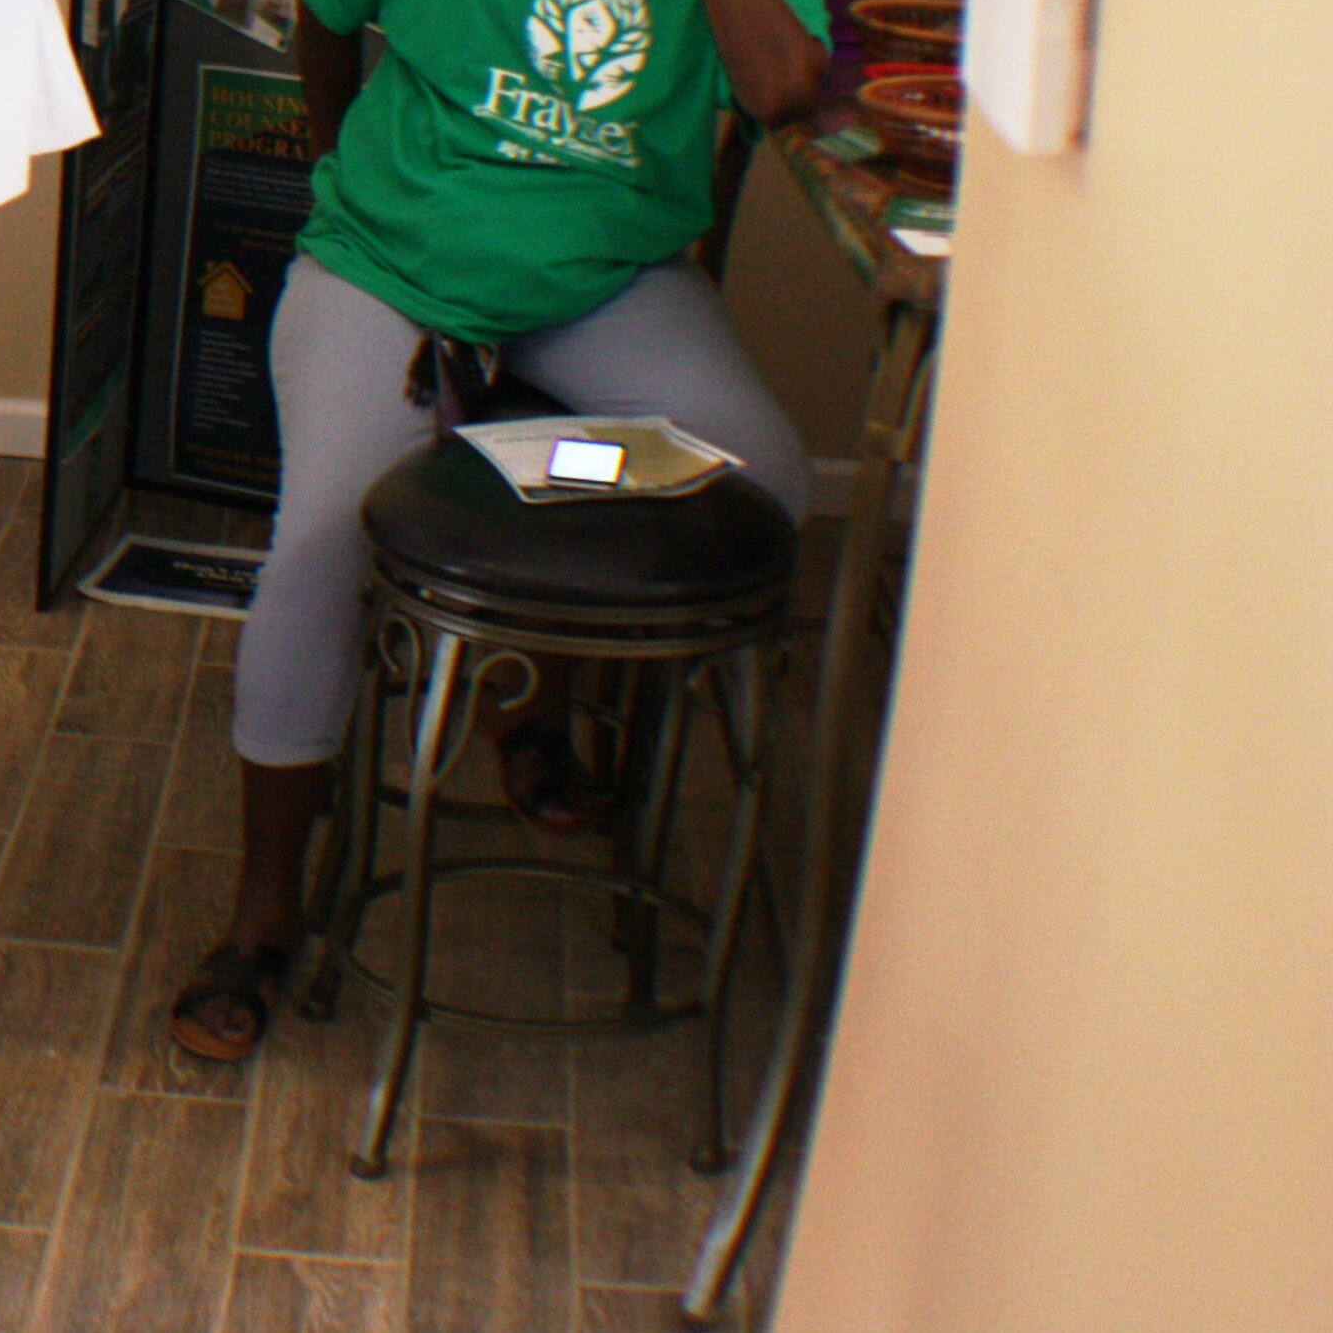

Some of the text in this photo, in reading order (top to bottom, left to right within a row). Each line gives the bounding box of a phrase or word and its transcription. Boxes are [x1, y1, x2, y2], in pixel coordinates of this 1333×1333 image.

[212, 87, 309, 114] HOUSIN
[209, 109, 314, 139] COUNSE
[209, 130, 309, 160] PROGRA
